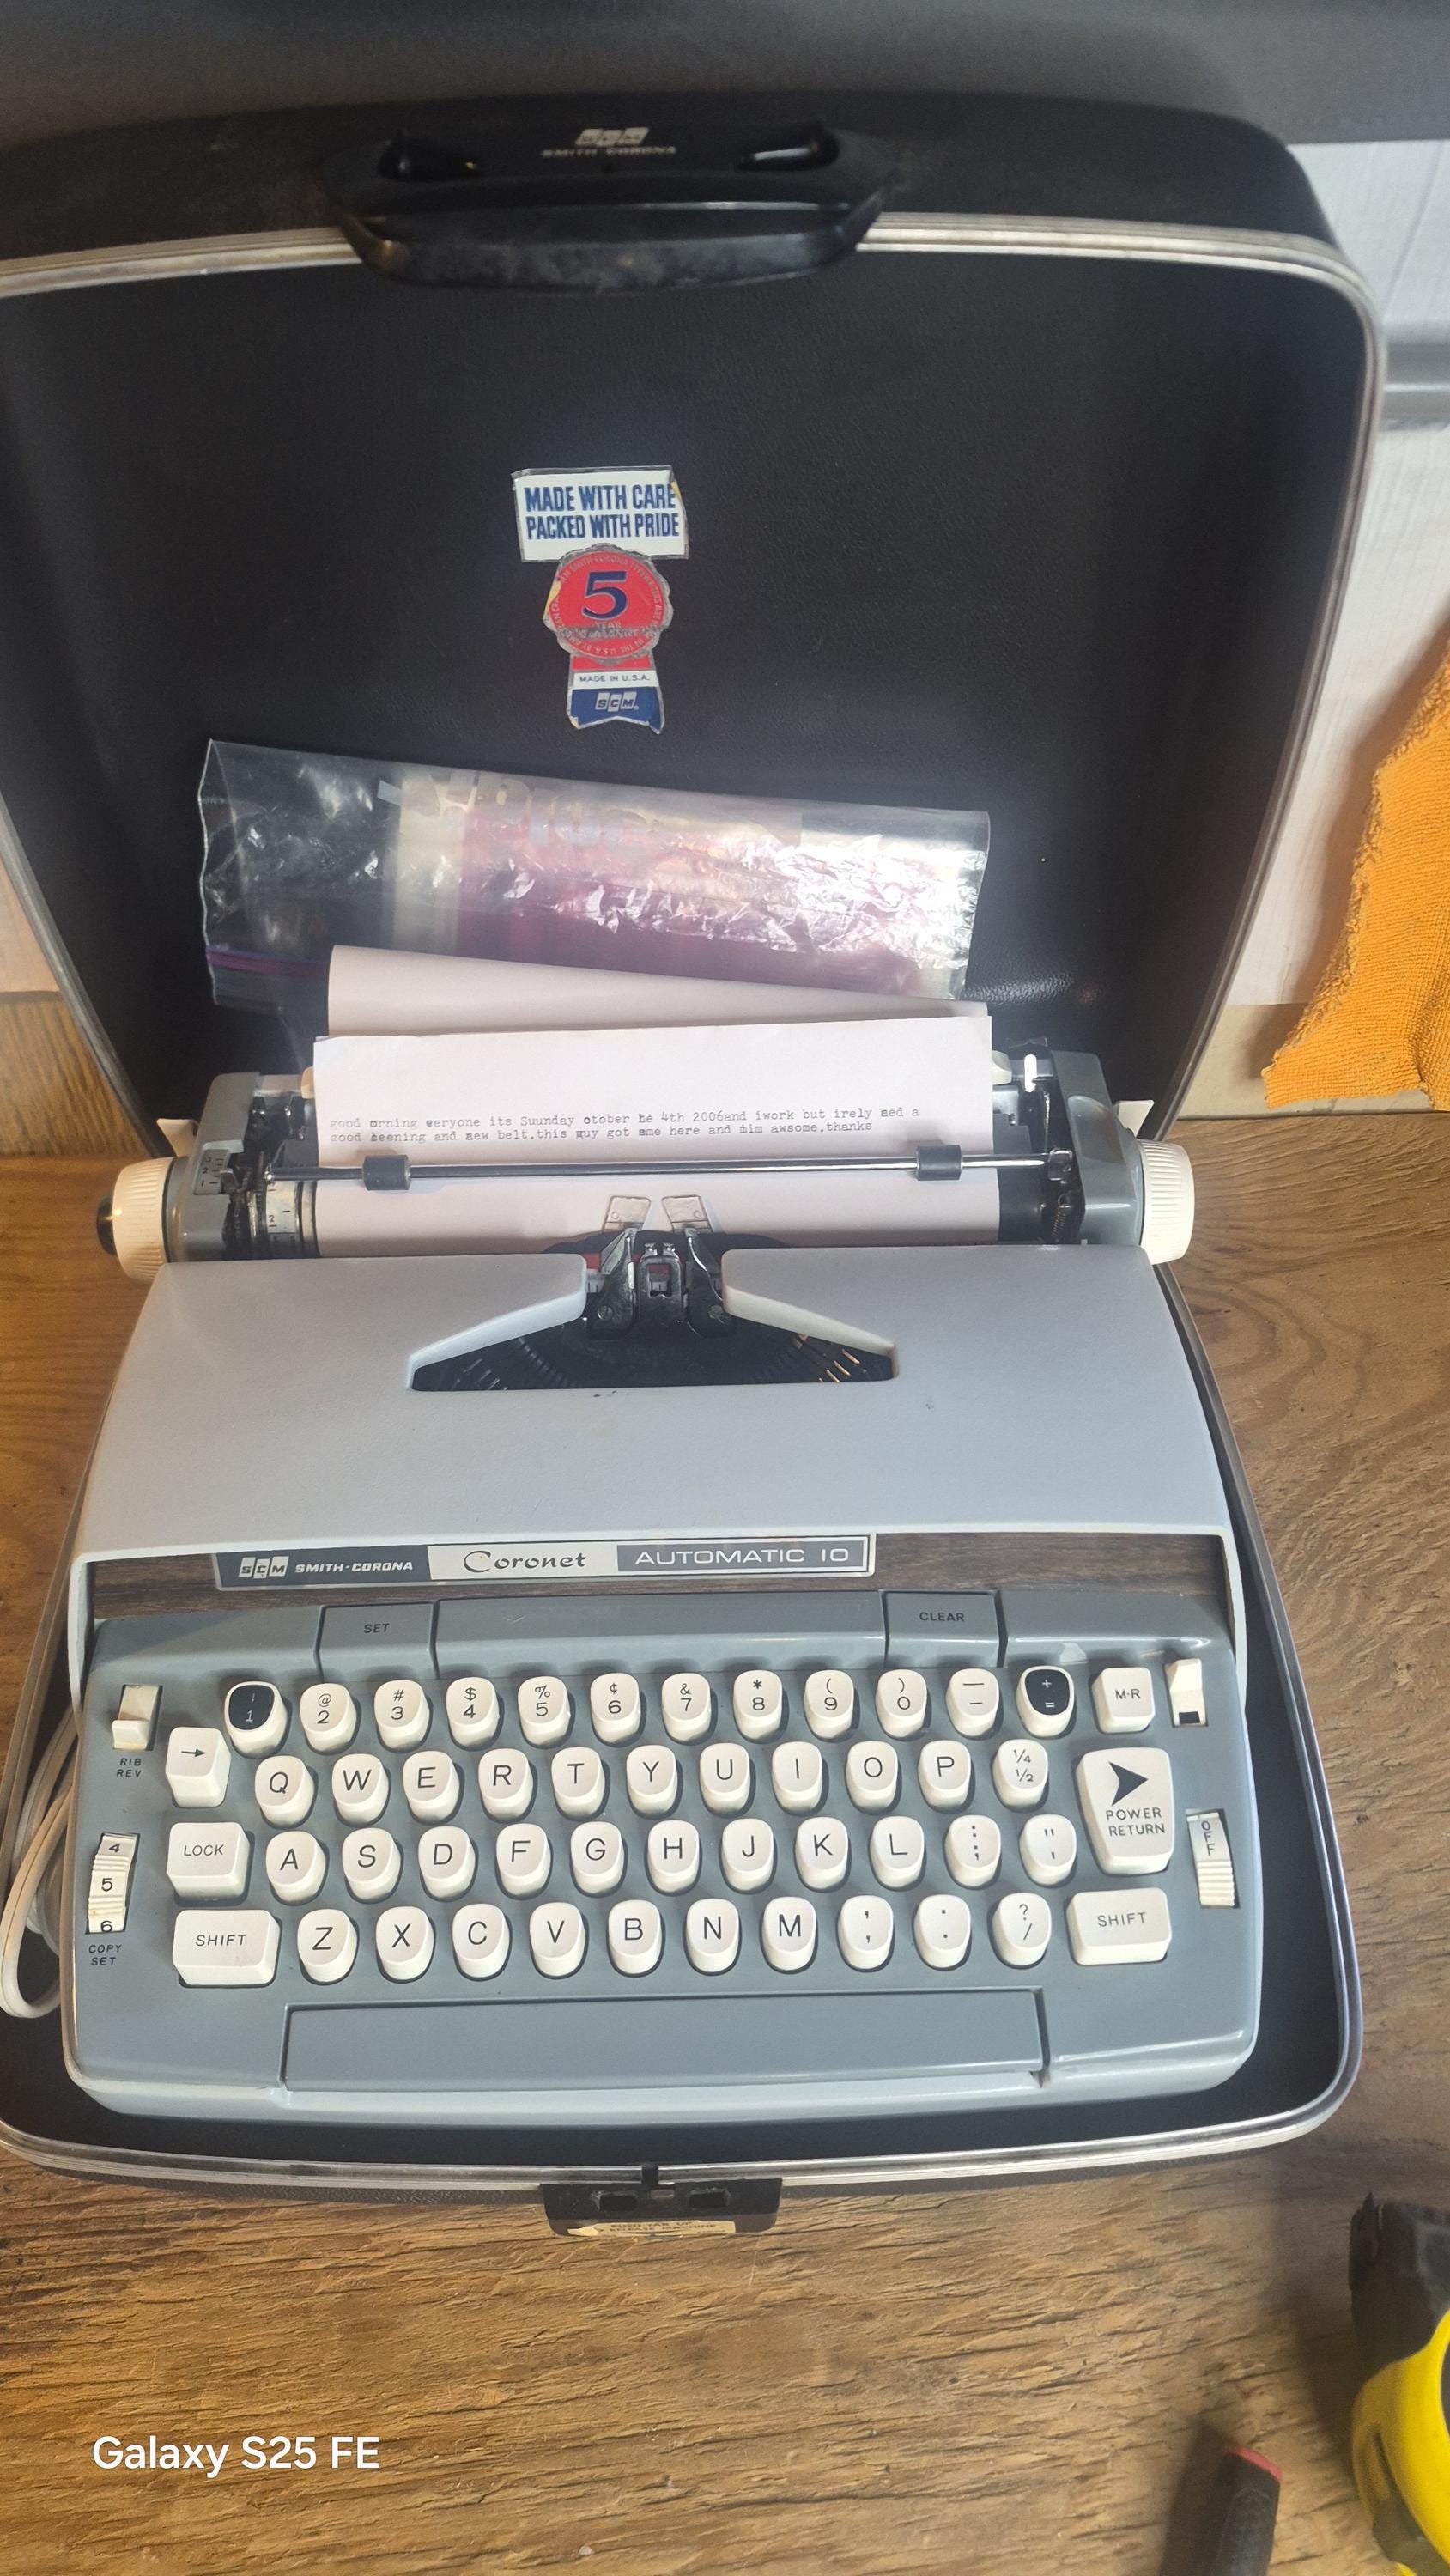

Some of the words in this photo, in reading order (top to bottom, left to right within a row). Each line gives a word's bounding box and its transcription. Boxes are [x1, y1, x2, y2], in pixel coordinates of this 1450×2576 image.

[525, 487, 574, 512] MADE
[579, 486, 626, 510] WITH
[632, 484, 676, 508] CARE
[526, 515, 585, 539] PACKED
[590, 514, 631, 538] WITH
[635, 513, 678, 537] PRIDE
[582, 571, 628, 621] 5
[595, 692, 637, 712] SCM
[331, 1118, 361, 1129] good
[489, 1115, 513, 1127] its
[520, 1115, 575, 1127] Suunday
[661, 1111, 685, 1122] 4th
[755, 1109, 794, 1121] iwork
[803, 1109, 825, 1120] but
[834, 1108, 872, 1120] irely
[912, 1108, 920, 1117] a
[331, 1132, 361, 1143] good
[434, 1131, 457, 1141] and
[606, 1127, 630, 1140] got
[670, 1125, 700, 1136] here
[708, 1124, 731, 1135] and
[240, 1556, 288, 1578] SCM
[463, 1549, 586, 1573] Coronet
[634, 1548, 805, 1565] AUTOMATIC
[919, 1612, 964, 1621] CLEAR
[364, 1623, 389, 1633] SET
[394, 1690, 403, 1701] #
[464, 1687, 476, 1701] $
[535, 1686, 550, 1699] %
[680, 1683, 691, 1695] &
[319, 1694, 331, 1707] @
[537, 1703, 548, 1716] 5
[609, 1700, 621, 1714] 6
[681, 1698, 691, 1711] 7
[753, 1697, 765, 1710] 8
[824, 1697, 837, 1710] 9
[246, 1710, 252, 1722] 1
[318, 1710, 329, 1723] 2
[391, 1706, 403, 1720] 3
[464, 1704, 476, 1718] 4
[120, 1758, 141, 1766] RIB
[717, 1759, 732, 1780] U
[864, 1757, 883, 1777] O
[937, 1757, 954, 1777] P
[117, 1769, 141, 1777] REV
[343, 1770, 371, 1791] W
[418, 1767, 435, 1788] E
[494, 1765, 511, 1786] R
[567, 1764, 584, 1783] T
[643, 1762, 658, 1782] Y
[270, 1772, 288, 1794] Q
[1106, 1807, 1162, 1820] POWER
[1109, 1824, 1165, 1836] RETURN
[109, 1844, 119, 1852] 4
[185, 1844, 223, 1856] LOCK
[512, 1840, 531, 1862] F
[586, 1838, 605, 1861] G
[664, 1838, 682, 1859] H
[743, 1836, 754, 1857] J
[814, 1834, 833, 1856] K
[889, 1834, 907, 1855] L
[280, 1849, 298, 1870] A
[358, 1845, 376, 1868] S
[434, 1844, 452, 1865] D
[101, 1878, 112, 1892] 5
[1019, 1904, 1028, 1920] ?
[1098, 1912, 1145, 1927] SHIFT
[100, 1920, 113, 1931] 6
[468, 1922, 487, 1945] C
[548, 1921, 564, 1943] V
[625, 1918, 643, 1940] B
[704, 1917, 721, 1939] N
[780, 1915, 801, 1936] M
[196, 1935, 246, 1946] SHIFT
[312, 1927, 333, 1950] Z
[392, 1924, 410, 1947] X
[89, 1945, 121, 1953] COPY
[91, 1957, 116, 1965] SET
